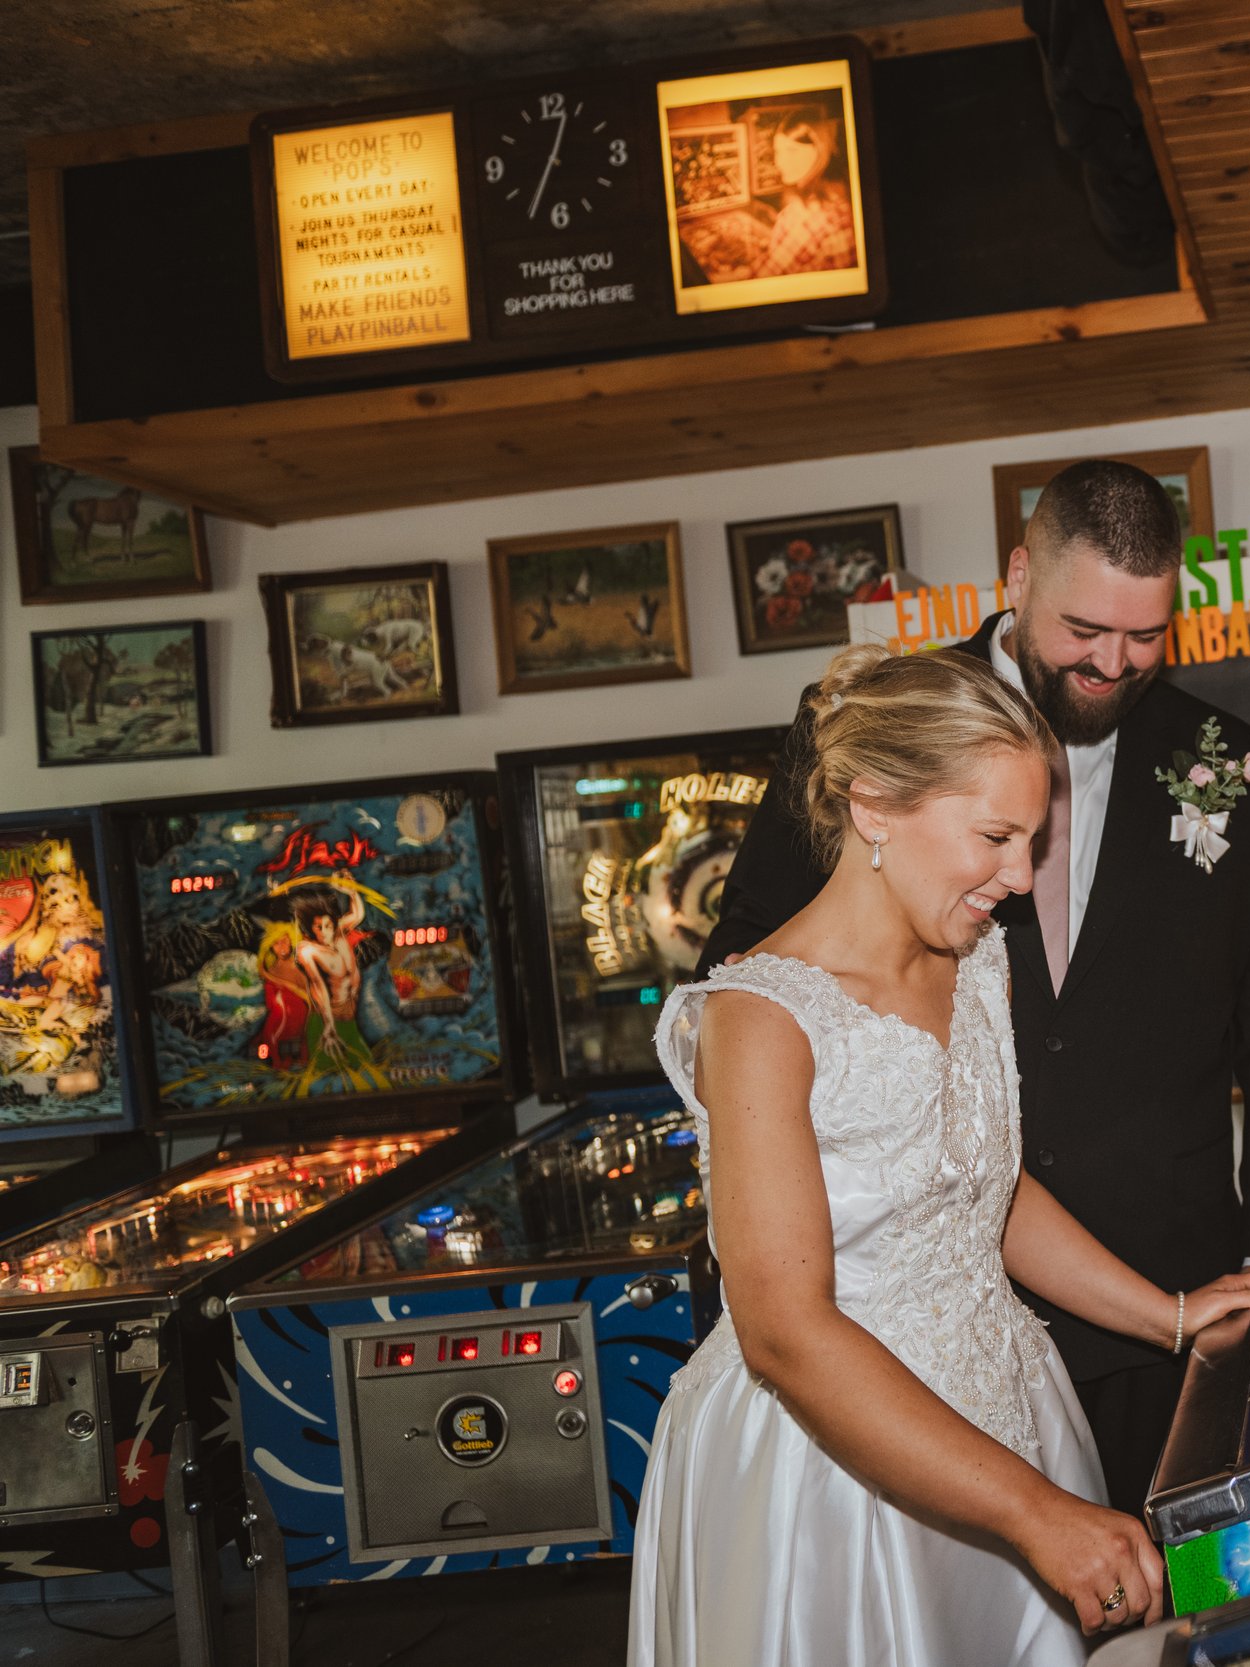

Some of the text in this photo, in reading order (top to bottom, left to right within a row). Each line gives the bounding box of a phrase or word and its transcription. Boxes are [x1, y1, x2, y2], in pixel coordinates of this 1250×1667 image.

[539, 93, 566, 120] 12
[294, 131, 423, 164] WELCOME TO
[609, 138, 628, 166] 3
[485, 156, 504, 183] 9
[300, 180, 428, 208] OPEN EVERY DAY
[301, 204, 434, 233] JOIN US THURSDAY
[551, 202, 570, 230] 6
[296, 221, 444, 251] NIGHTS FOR CASUAL
[318, 241, 425, 267] TOURNAMENTS
[519, 251, 614, 279] THANK YOU
[313, 265, 431, 293] PARTY RENTALS
[550, 272, 586, 292] FOR
[300, 285, 451, 322] MAKE FRIENDS
[504, 283, 635, 316] SHOPPING HERE
[307, 313, 447, 346] PLAY PINBALL
[453, 1440, 494, 1451] Gottlieb
